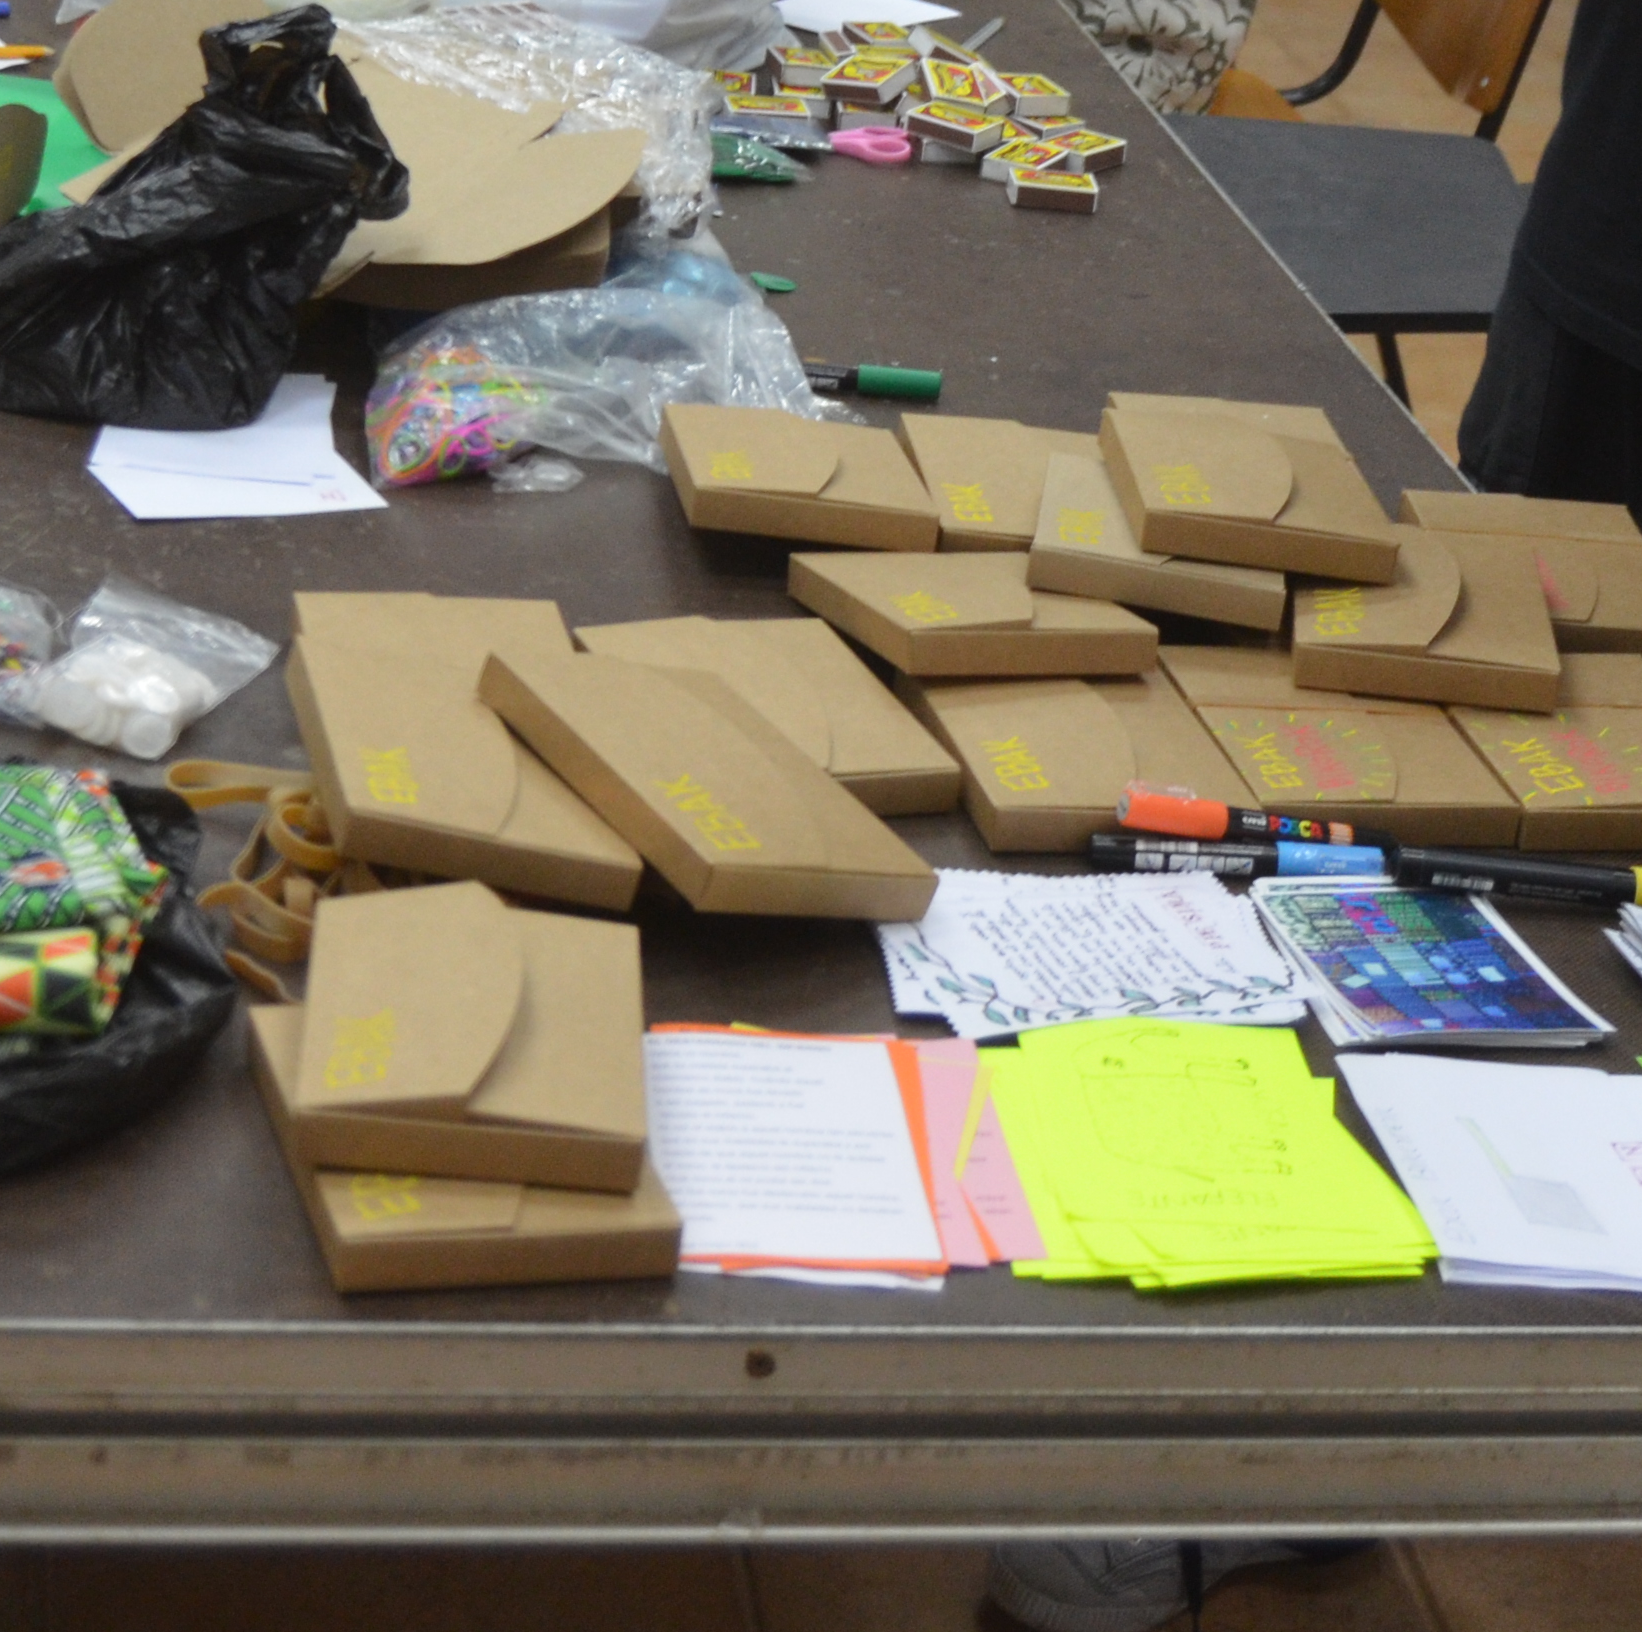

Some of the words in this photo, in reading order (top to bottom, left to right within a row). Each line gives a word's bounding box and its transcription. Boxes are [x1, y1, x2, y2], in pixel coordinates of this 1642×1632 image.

[981, 735, 1051, 793] EBAK
[1237, 731, 1305, 789] EBAK
[1502, 736, 1586, 795] EBAK
[654, 772, 763, 852] EBAK
[1269, 814, 1324, 840] POSCA
